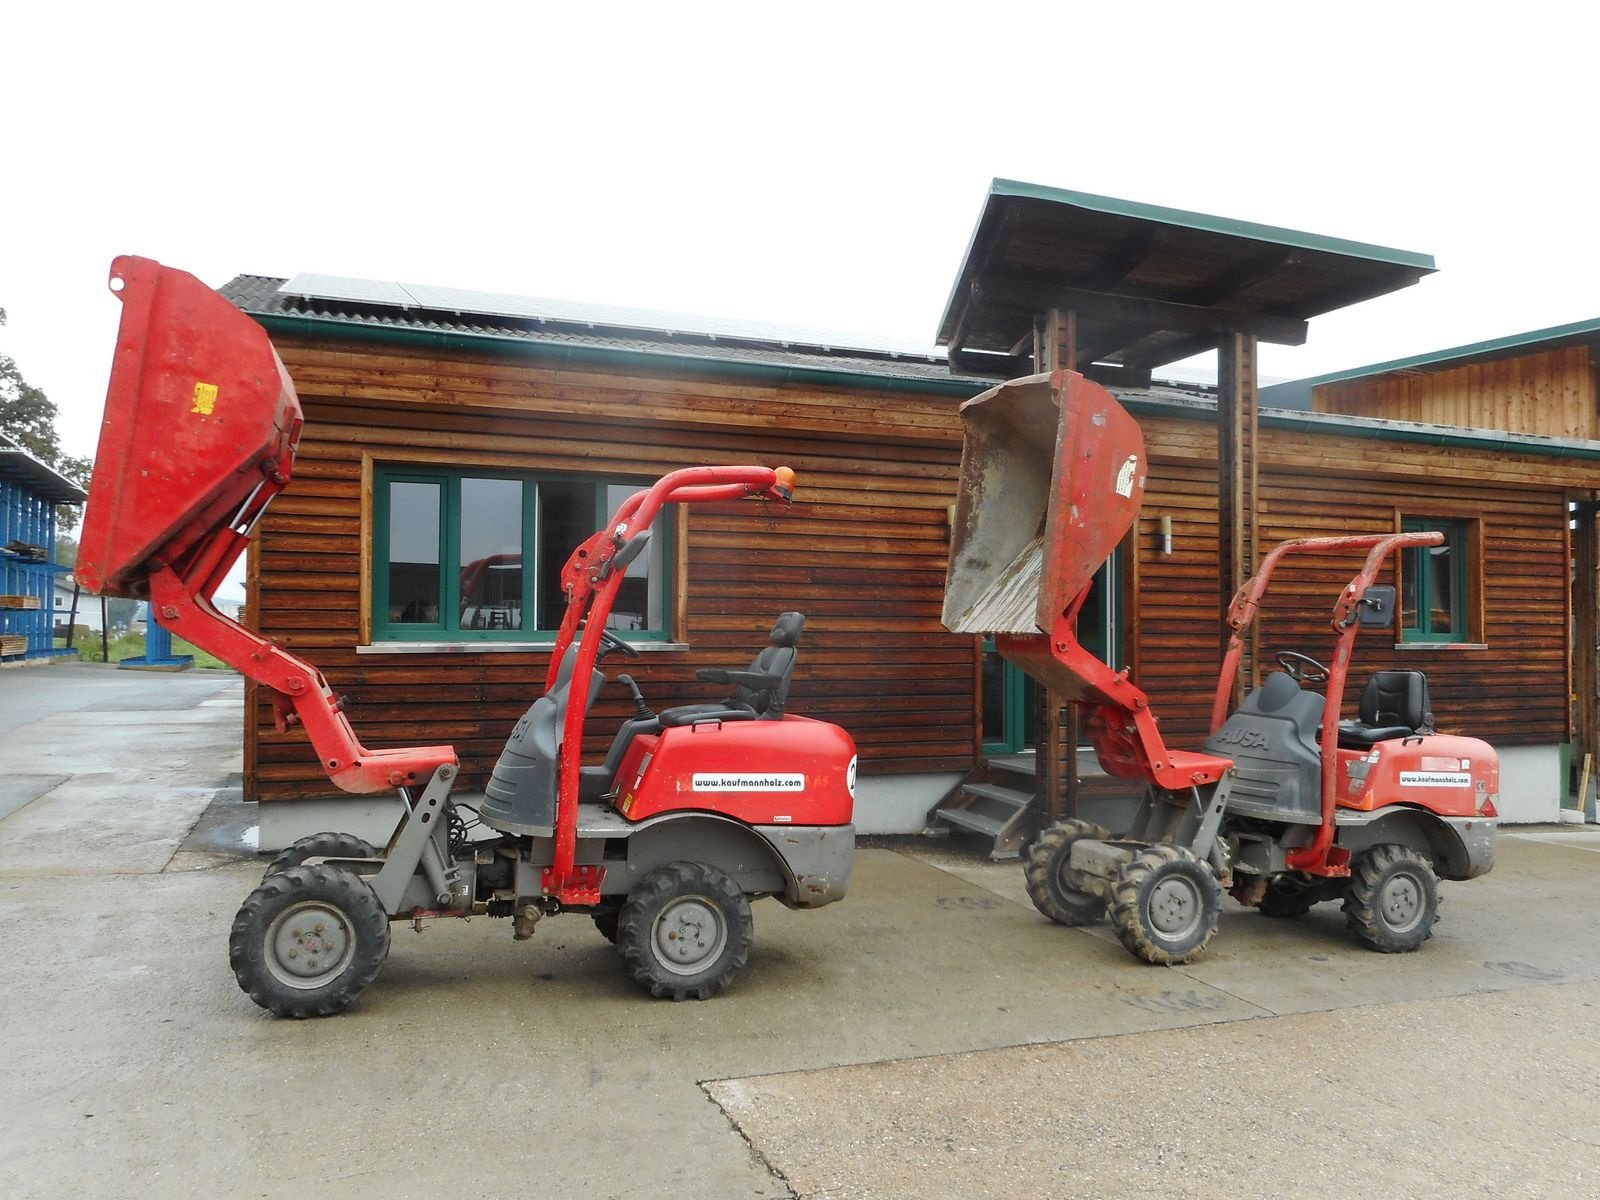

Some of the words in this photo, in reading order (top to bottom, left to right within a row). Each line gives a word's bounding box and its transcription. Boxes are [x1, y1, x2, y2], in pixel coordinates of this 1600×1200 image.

[1217, 728, 1271, 751] AUSA
[694, 777, 802, 788] www.kaufmannholz.com
[1401, 774, 1469, 785] www.kaufmannholz.com
